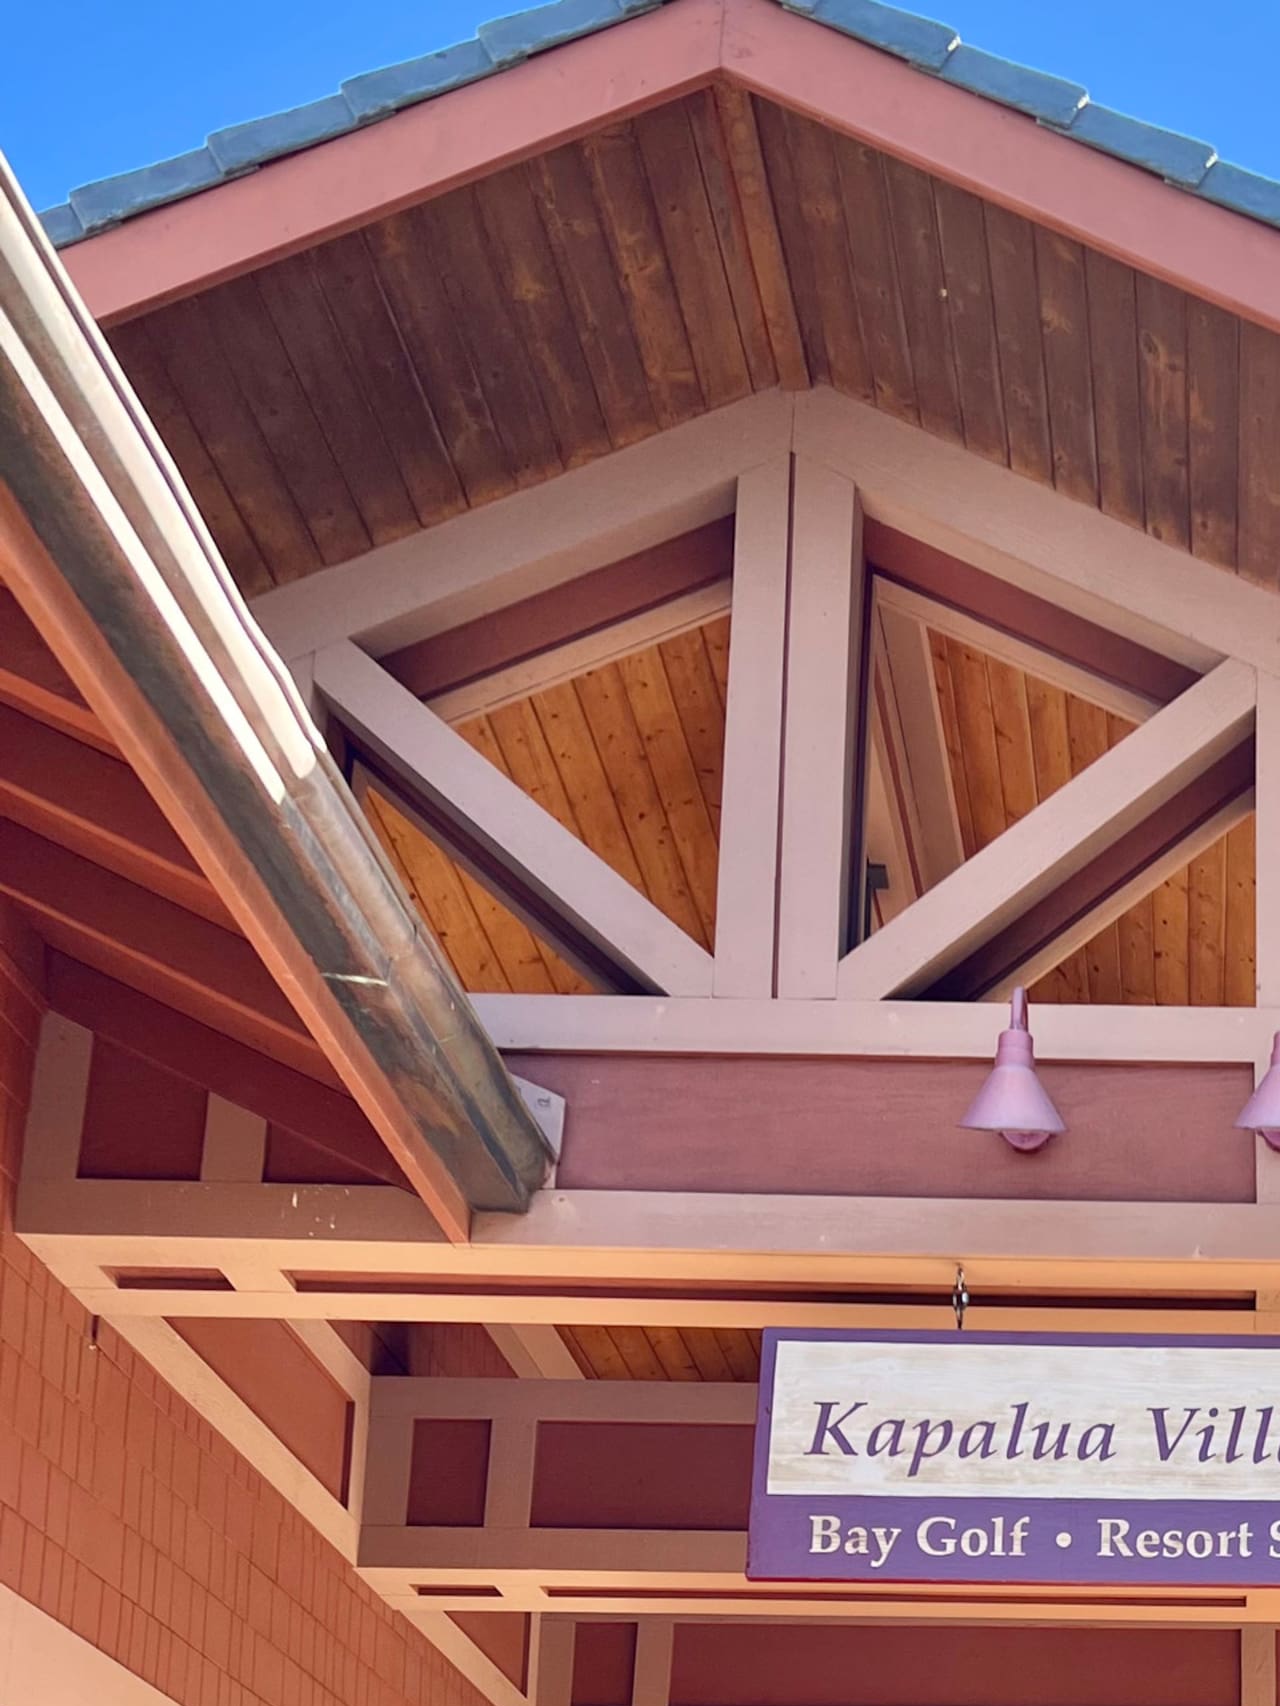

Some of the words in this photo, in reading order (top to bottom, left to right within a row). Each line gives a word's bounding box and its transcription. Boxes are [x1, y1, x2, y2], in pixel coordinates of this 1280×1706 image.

[803, 1401, 1117, 1477] Kapalua
[808, 1515, 901, 1568] Bay
[916, 1516, 1031, 1557] Golf
[1096, 1518, 1253, 1558] Resort
